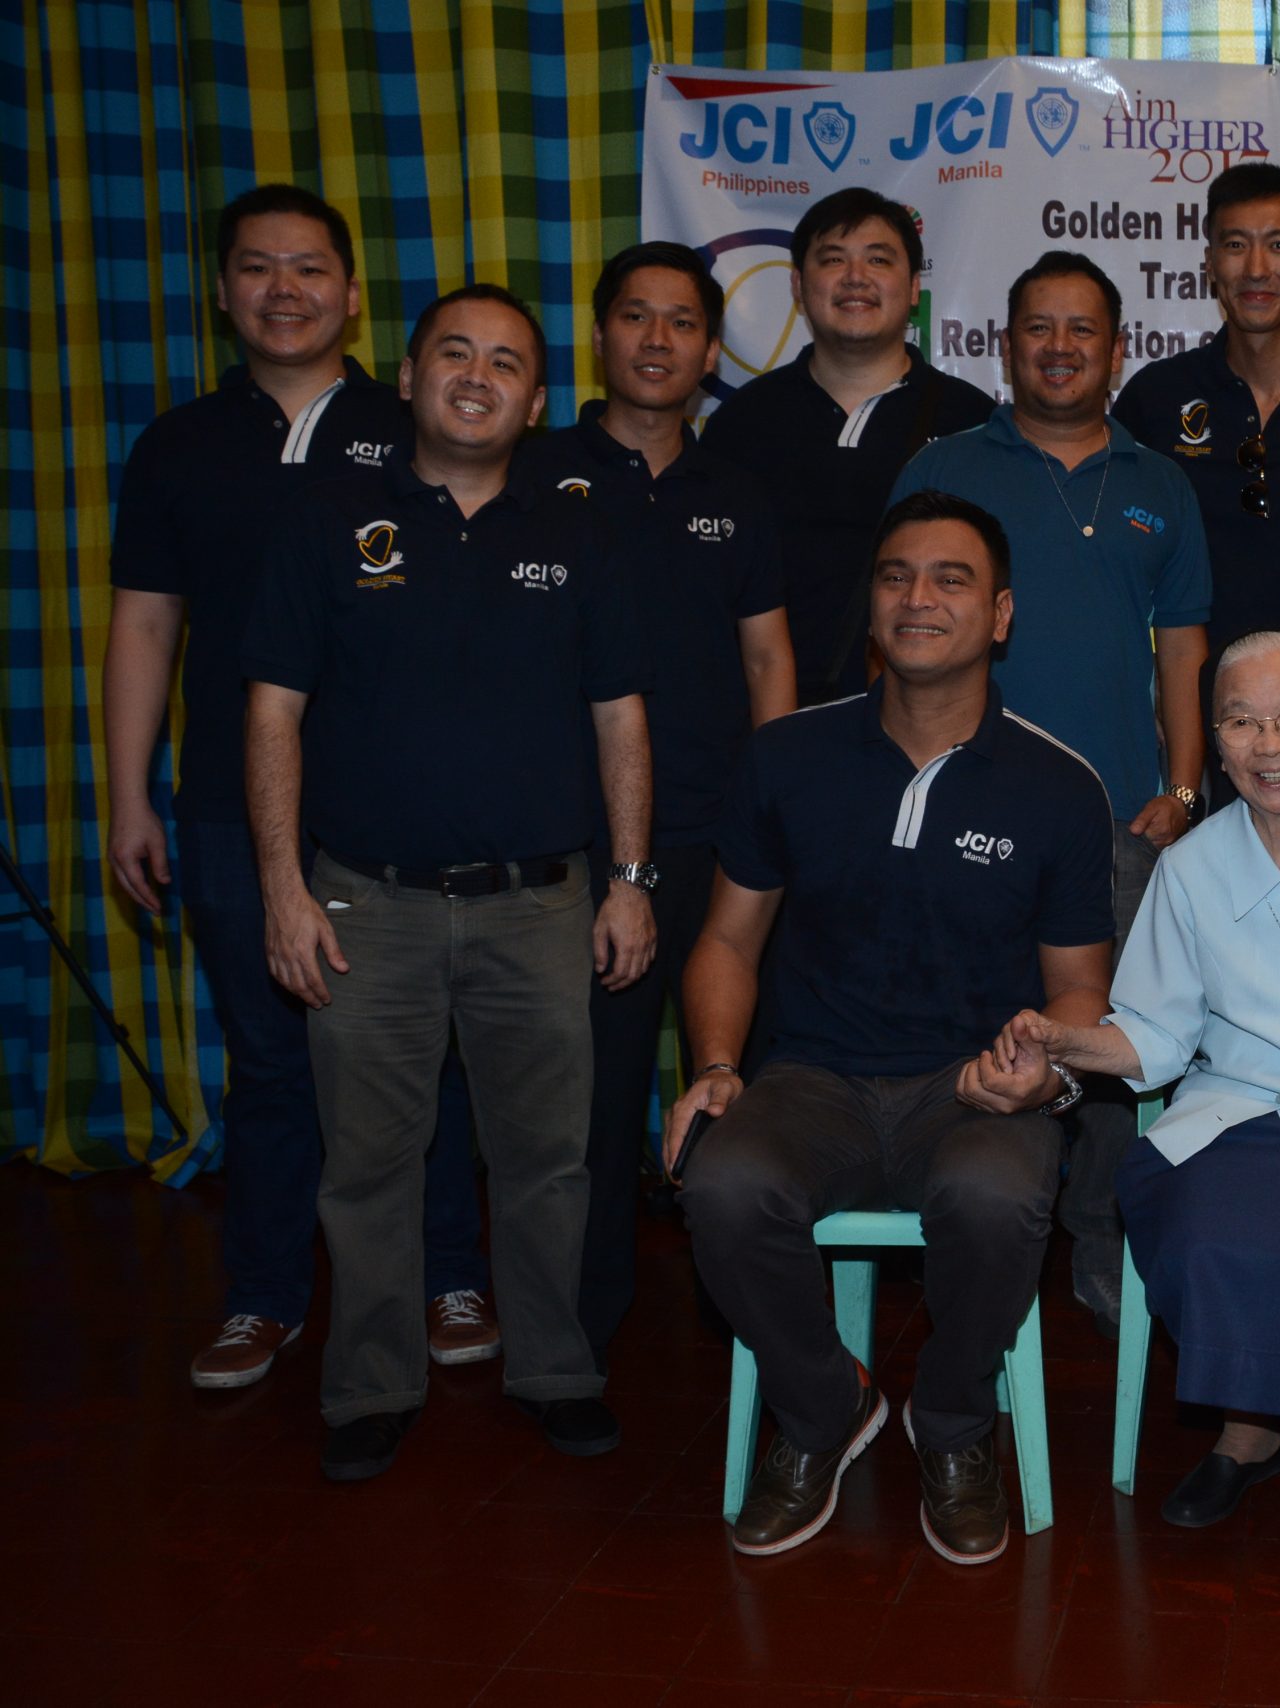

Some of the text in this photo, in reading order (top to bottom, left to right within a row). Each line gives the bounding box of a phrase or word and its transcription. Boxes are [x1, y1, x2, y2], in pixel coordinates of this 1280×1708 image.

[680, 102, 791, 164] JCI
[890, 92, 1014, 161] JCI
[1103, 116, 1270, 151] HIGHER
[702, 170, 810, 196] Philippines
[938, 160, 1003, 184] Manila
[1042, 200, 1162, 239] Golden
[1140, 261, 1218, 300] Trai
[345, 440, 382, 459] JCI
[354, 456, 383, 467] Manila
[687, 516, 719, 534] JCI
[1123, 505, 1154, 526] JCI
[510, 562, 548, 581] JCI
[955, 830, 996, 854] JCI
[962, 850, 991, 865] Manila
